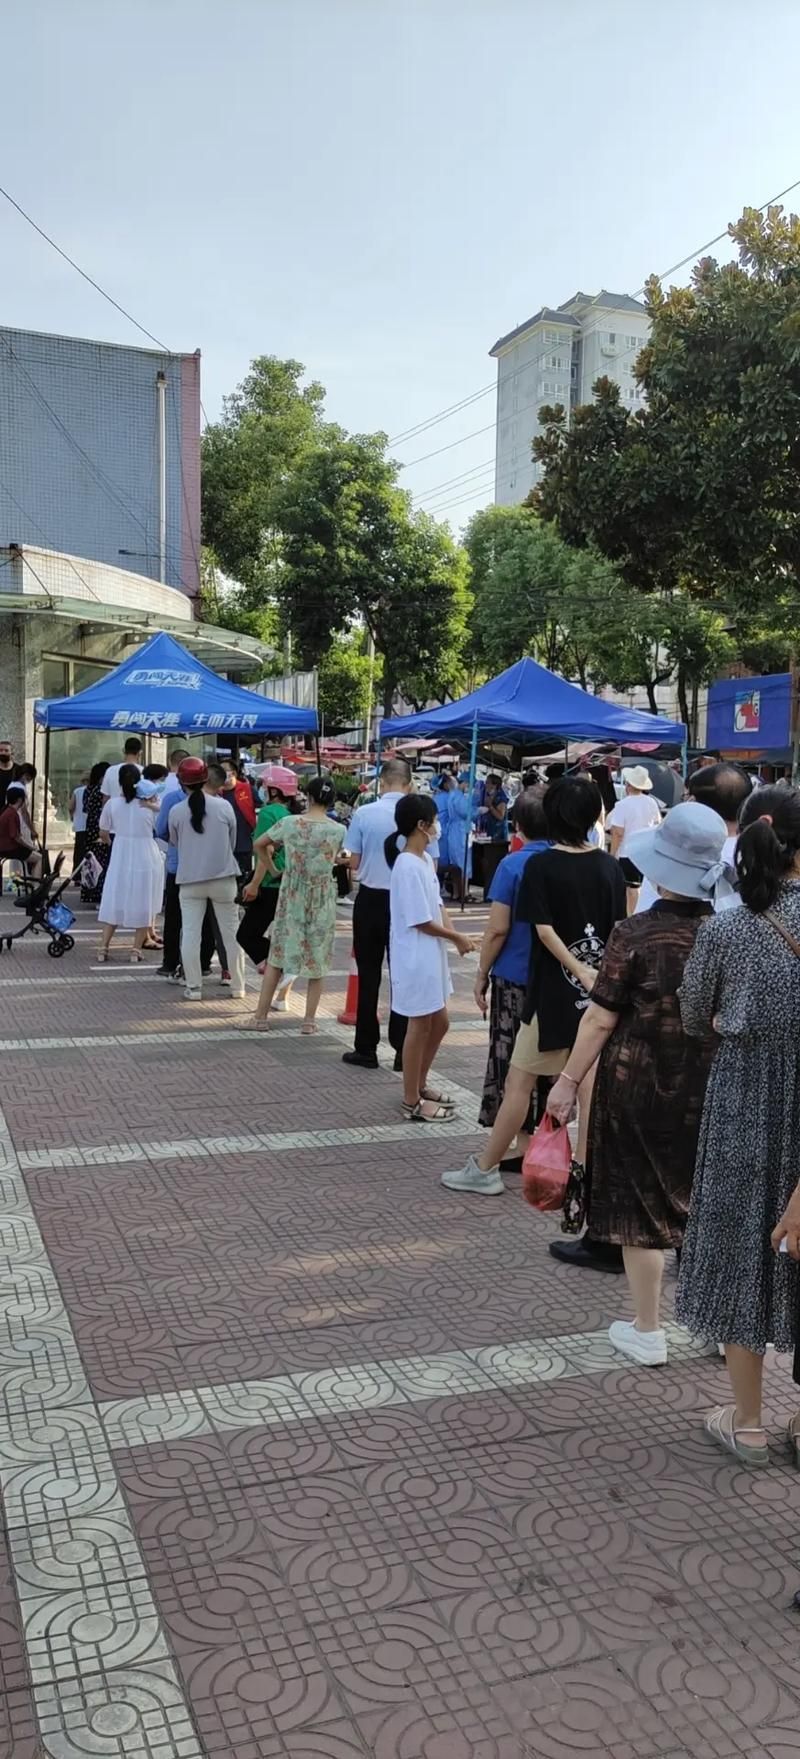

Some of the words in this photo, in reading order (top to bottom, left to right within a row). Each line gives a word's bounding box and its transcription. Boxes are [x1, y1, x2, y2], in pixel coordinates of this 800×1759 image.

[110, 711, 181, 729] 勇闯天涯
[190, 713, 258, 728] 生而无畏
